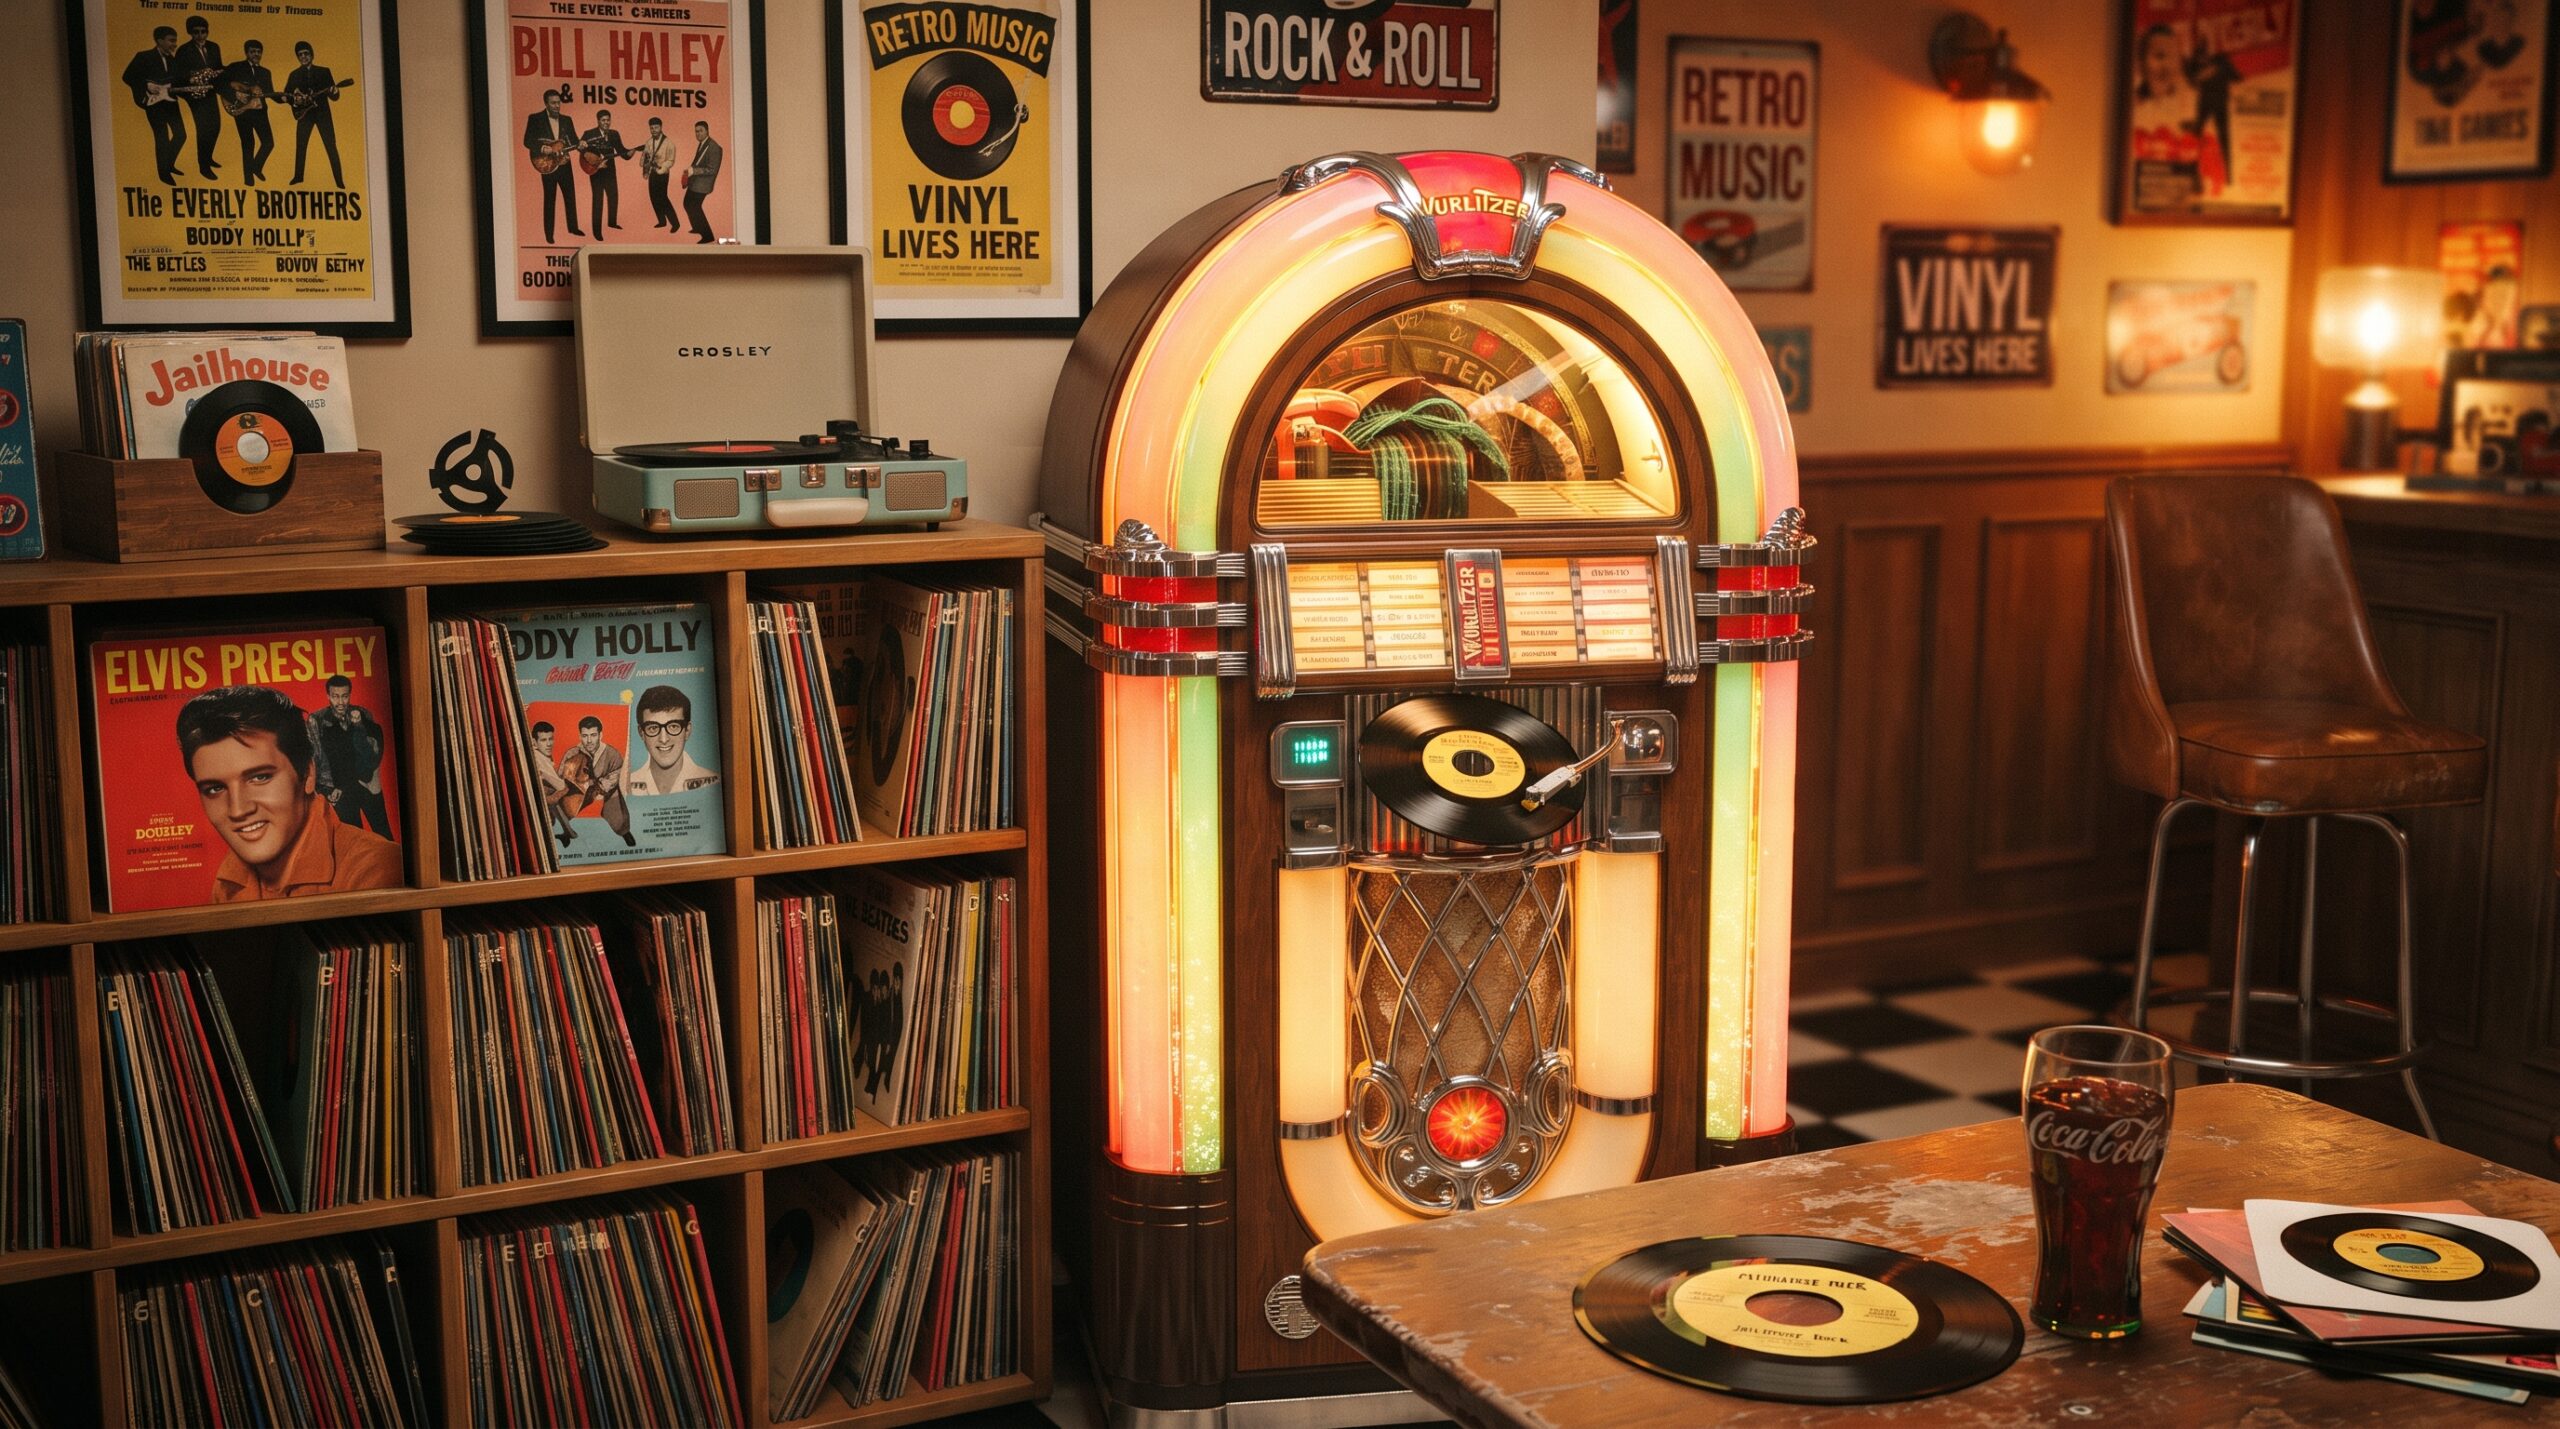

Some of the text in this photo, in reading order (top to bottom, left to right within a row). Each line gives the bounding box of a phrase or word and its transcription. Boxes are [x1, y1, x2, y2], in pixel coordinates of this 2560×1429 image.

[549, 2, 575, 14] THE
[513, 25, 725, 84] BILL HALEY
[870, 8, 1049, 64] RETRO MUSIC
[1224, 11, 1481, 89] ROCK & ROLL
[559, 83, 708, 109] & HIS COMETS
[1682, 66, 1806, 128] RETRO
[1680, 140, 1805, 202] MUSIC
[123, 187, 362, 221] The EVERLY BROTHERS
[908, 184, 1019, 225] VINYL
[186, 227, 244, 246] BODDY
[883, 229, 1040, 260] LIVES HERE
[126, 256, 150, 272] THE
[1897, 258, 2042, 331] VINYL
[678, 346, 773, 358] CROSLEY
[1896, 337, 2038, 373] LIVES HERE
[145, 347, 330, 407] Jailhouse
[595, 620, 701, 657] HOLLY
[105, 636, 376, 694] ELVIS PRESLEY
